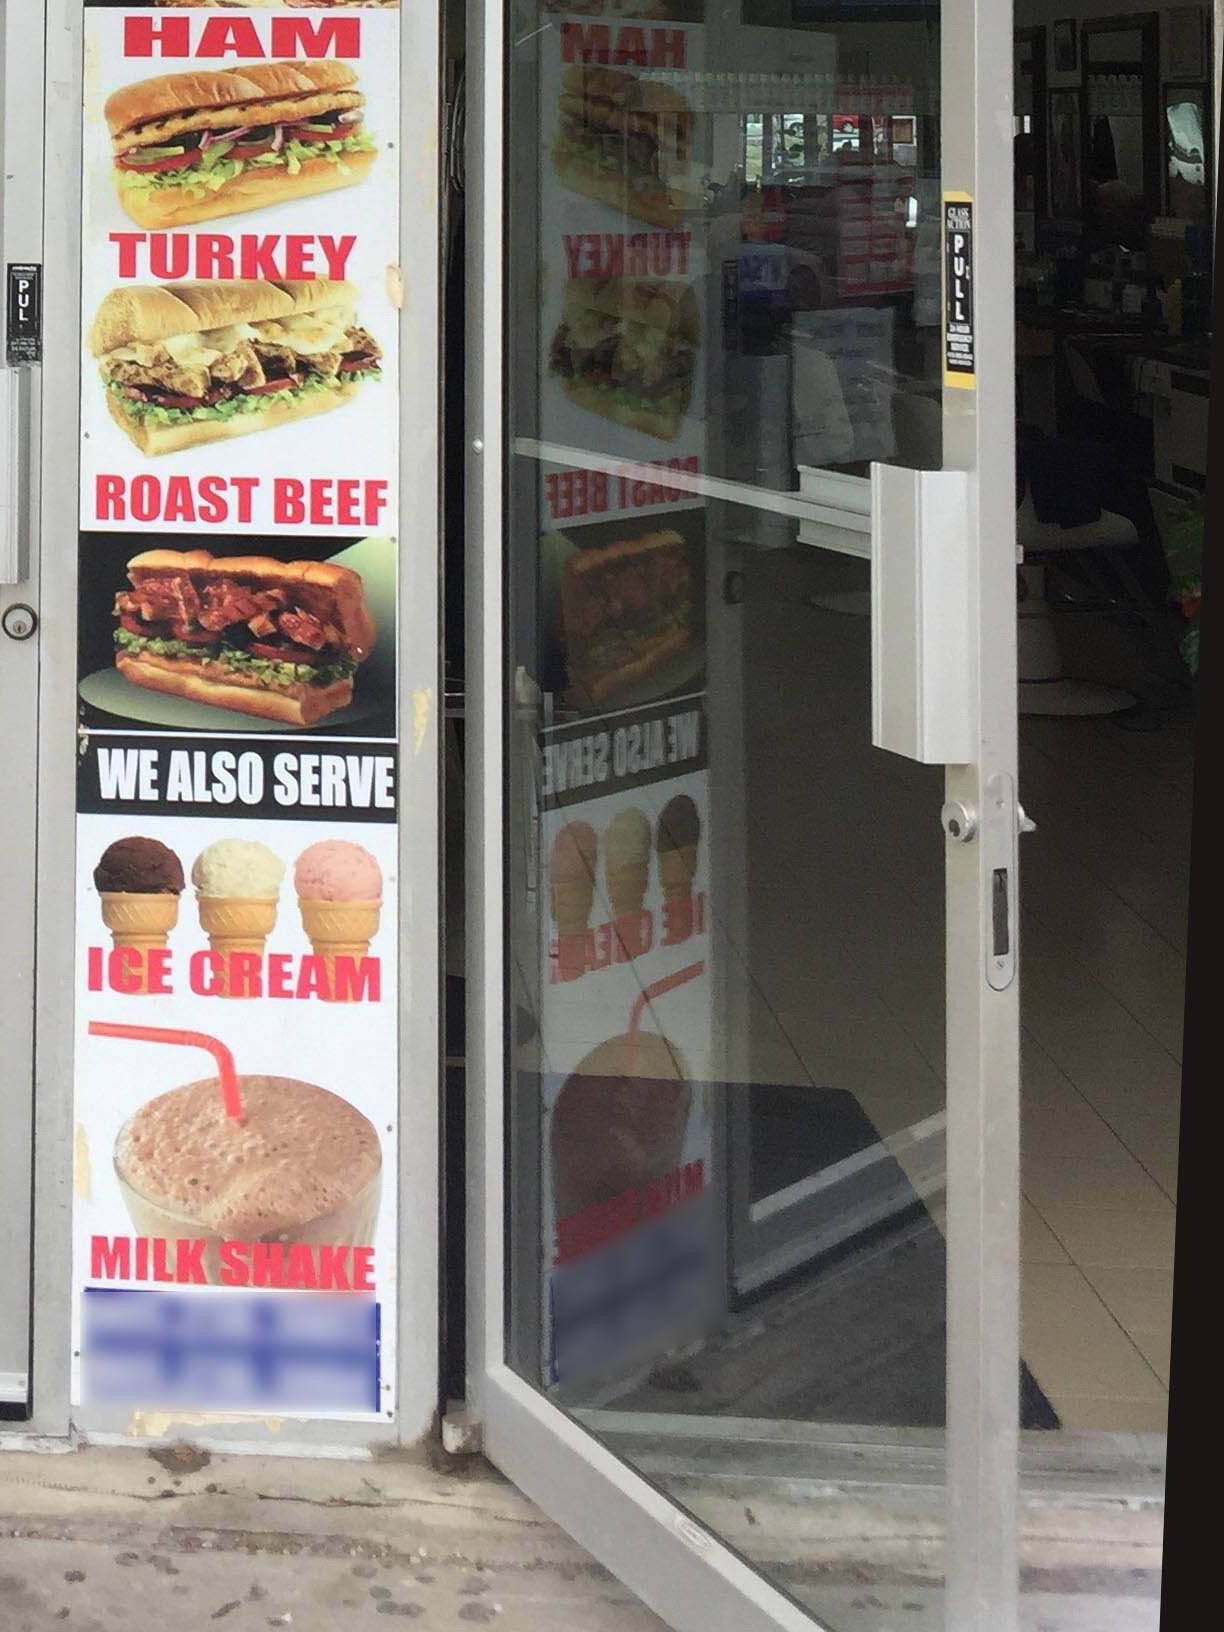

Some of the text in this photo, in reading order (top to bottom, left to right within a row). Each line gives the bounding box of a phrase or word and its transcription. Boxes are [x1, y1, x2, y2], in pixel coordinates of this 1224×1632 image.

[124, 16, 360, 58] HAM
[109, 231, 357, 281] TURKEY
[953, 234, 965, 320] PULL
[18, 279, 30, 321] PUL
[95, 474, 388, 526] ROAST BEEF
[97, 748, 395, 810] WE ALSO SERVE
[88, 946, 382, 1003] ICE CREAM
[90, 1234, 376, 1292] MILK SHAKE
